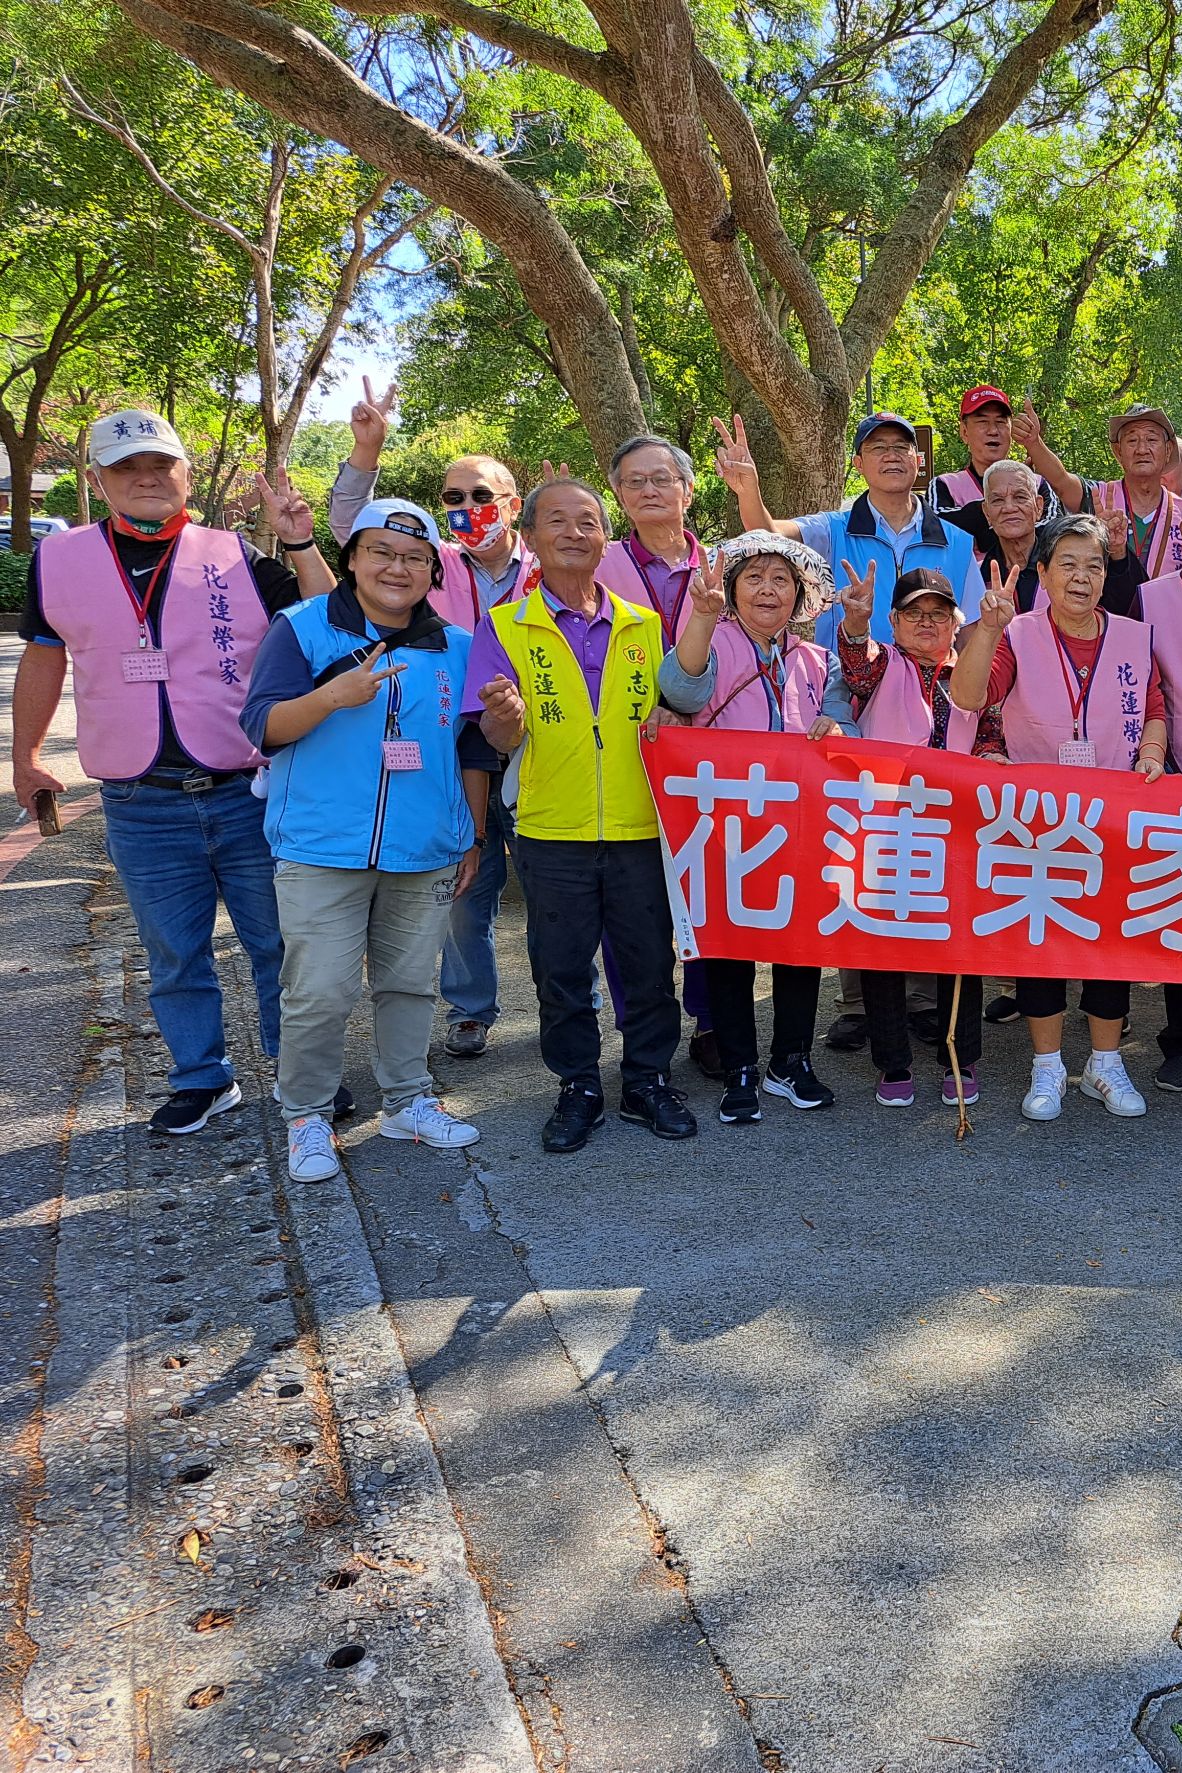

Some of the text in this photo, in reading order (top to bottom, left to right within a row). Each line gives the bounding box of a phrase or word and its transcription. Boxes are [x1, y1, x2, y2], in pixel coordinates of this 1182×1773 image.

[202, 564, 241, 685] 花蓮榮家
[434, 670, 452, 727] 花蓮榮家
[529, 646, 566, 725] 花蓮縣
[627, 670, 649, 721] 志工
